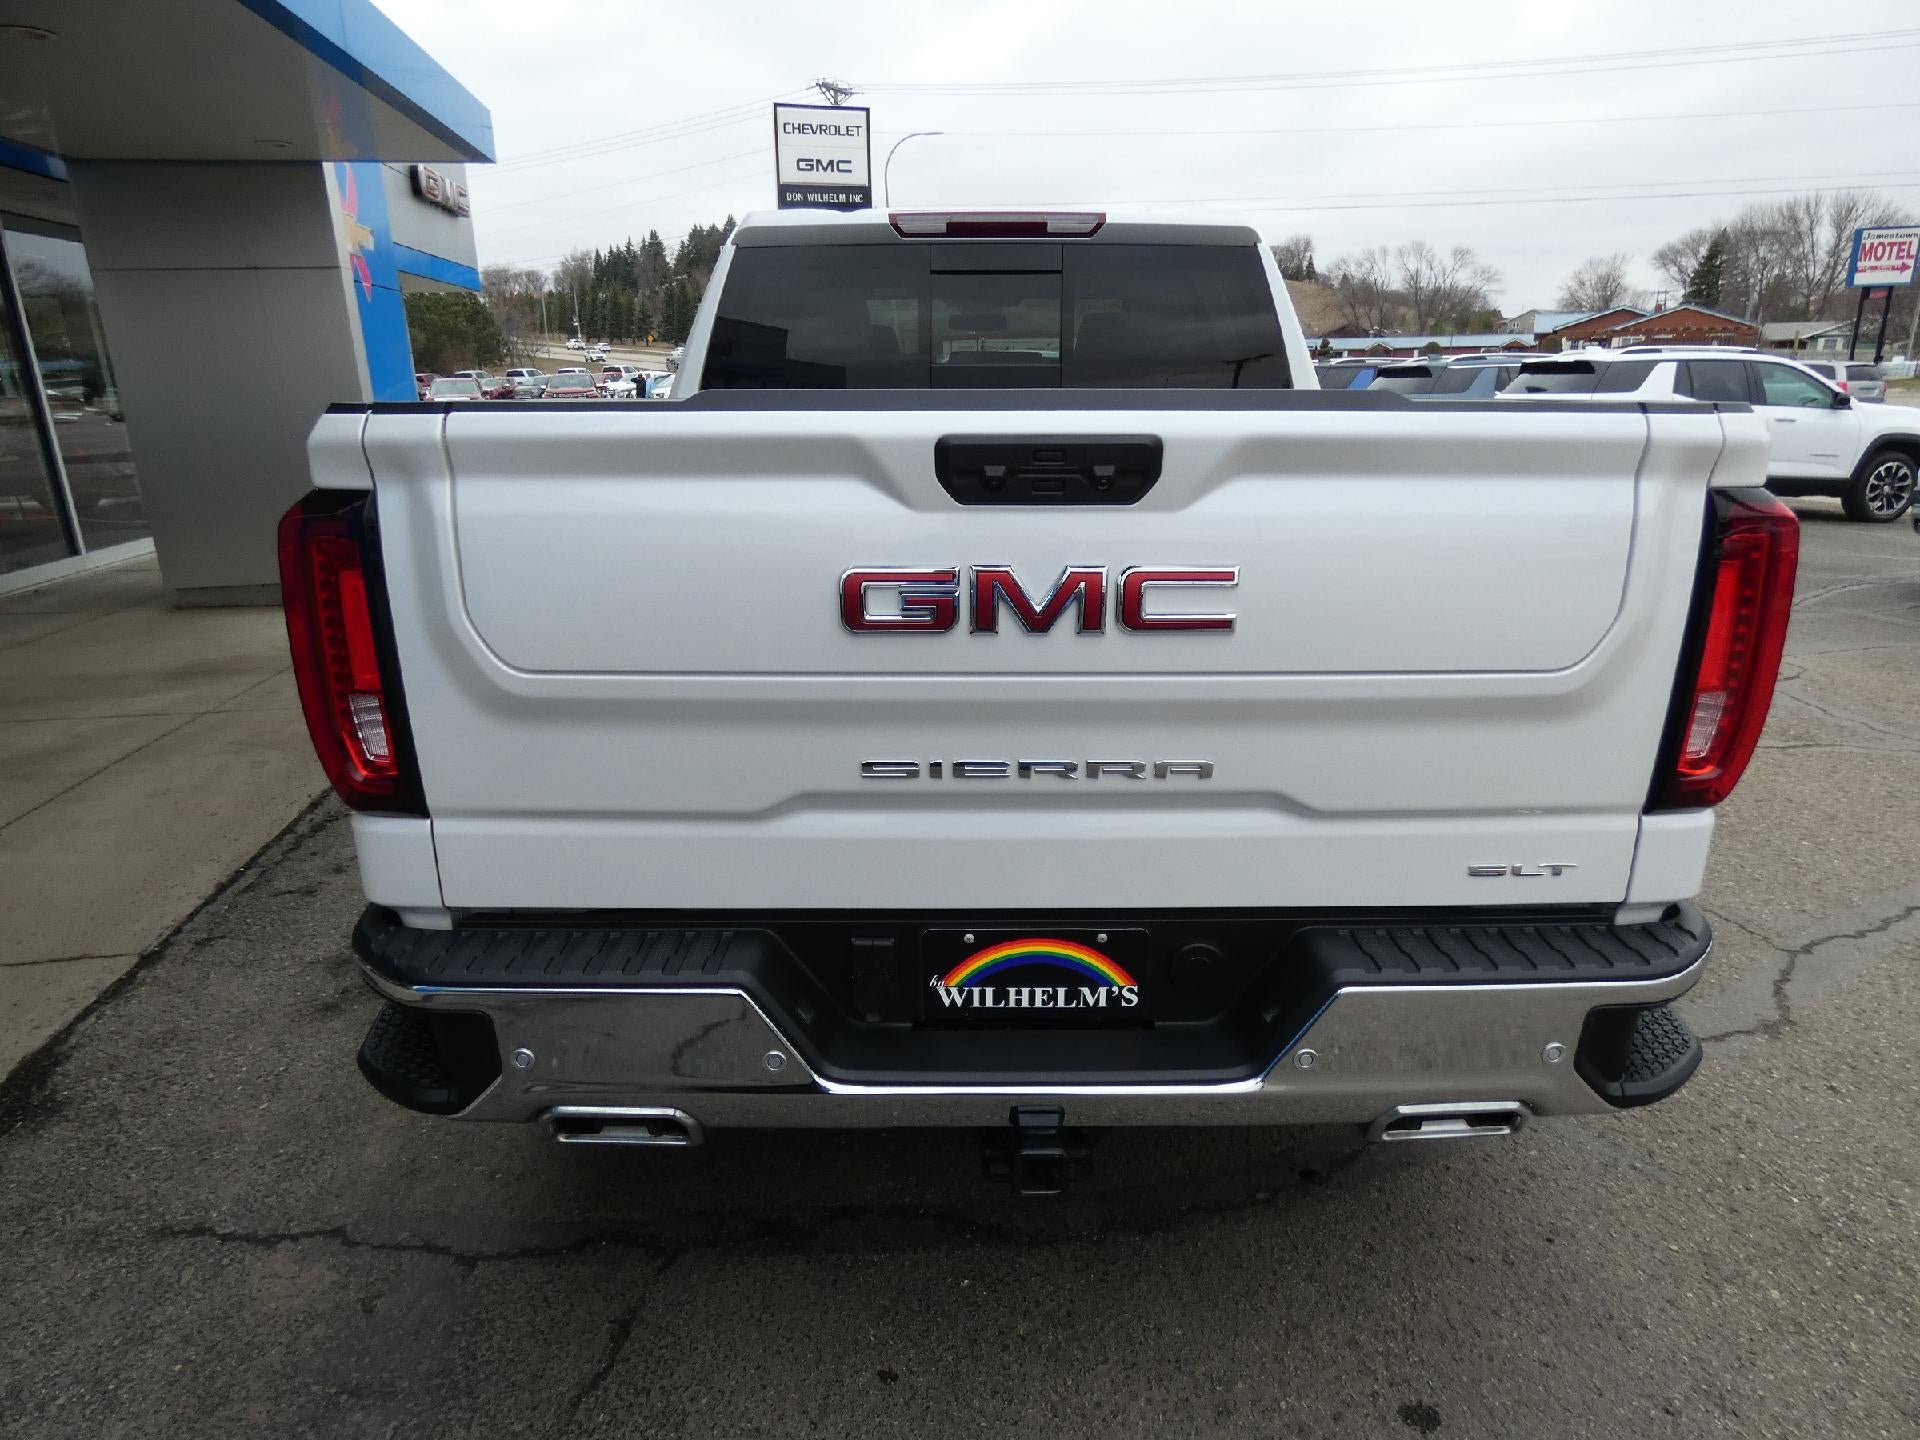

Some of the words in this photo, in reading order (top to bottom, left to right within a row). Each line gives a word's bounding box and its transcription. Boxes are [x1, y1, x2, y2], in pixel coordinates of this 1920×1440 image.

[782, 122, 862, 137] CHEVROLET
[796, 157, 853, 174] GMC
[410, 163, 470, 218] GMC
[786, 192, 803, 202] DON
[807, 192, 846, 203] WILHELM
[849, 193, 864, 203] INC
[1859, 240, 1915, 262] MOTEL
[839, 564, 1240, 635] GMC
[861, 758, 1215, 780] SIERRA
[1468, 862, 1579, 877] SLT
[935, 985, 1140, 1008] WILHELM'S
